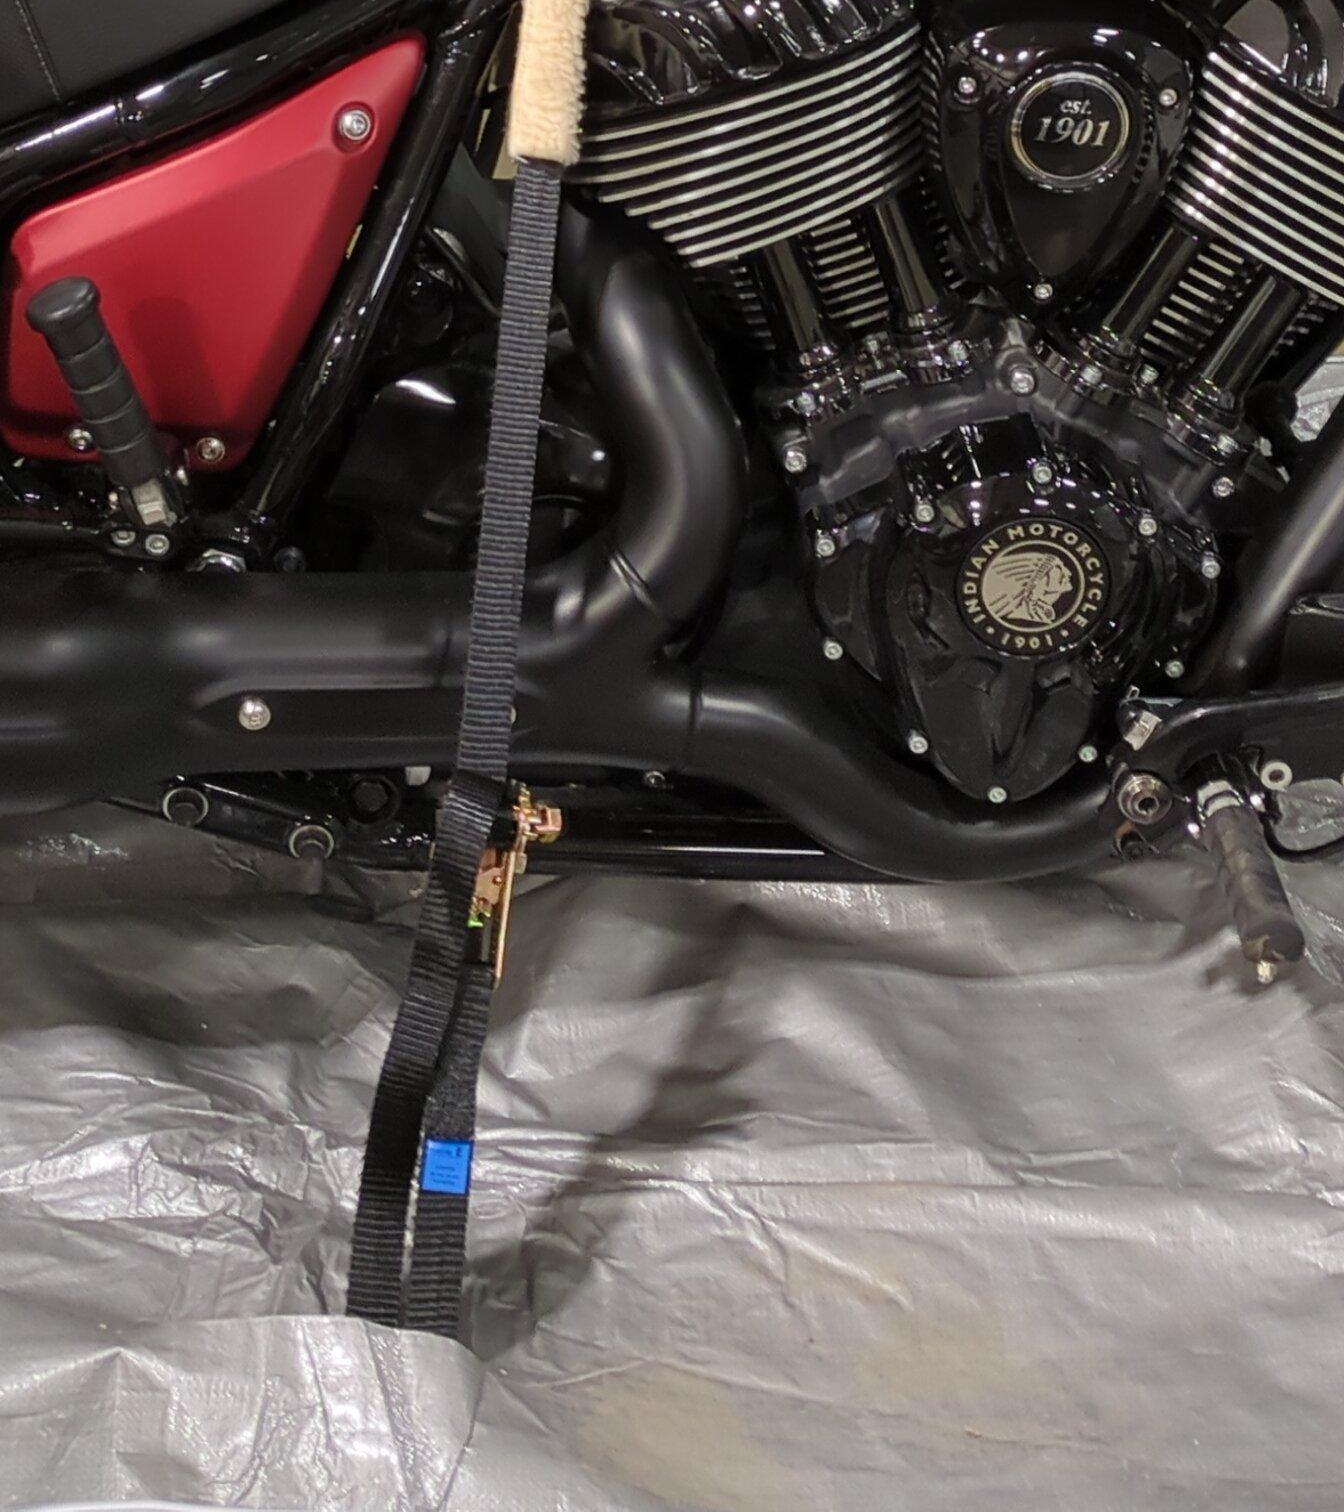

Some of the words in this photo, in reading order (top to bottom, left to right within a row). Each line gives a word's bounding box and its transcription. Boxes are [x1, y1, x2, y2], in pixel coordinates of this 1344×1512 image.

[1059, 98, 1092, 115] est.
[1033, 115, 1111, 147] 1901
[962, 539, 1001, 624] INDIAN
[1006, 522, 1105, 629] MOTORCYCLE
[1000, 633, 1054, 650] 1901
